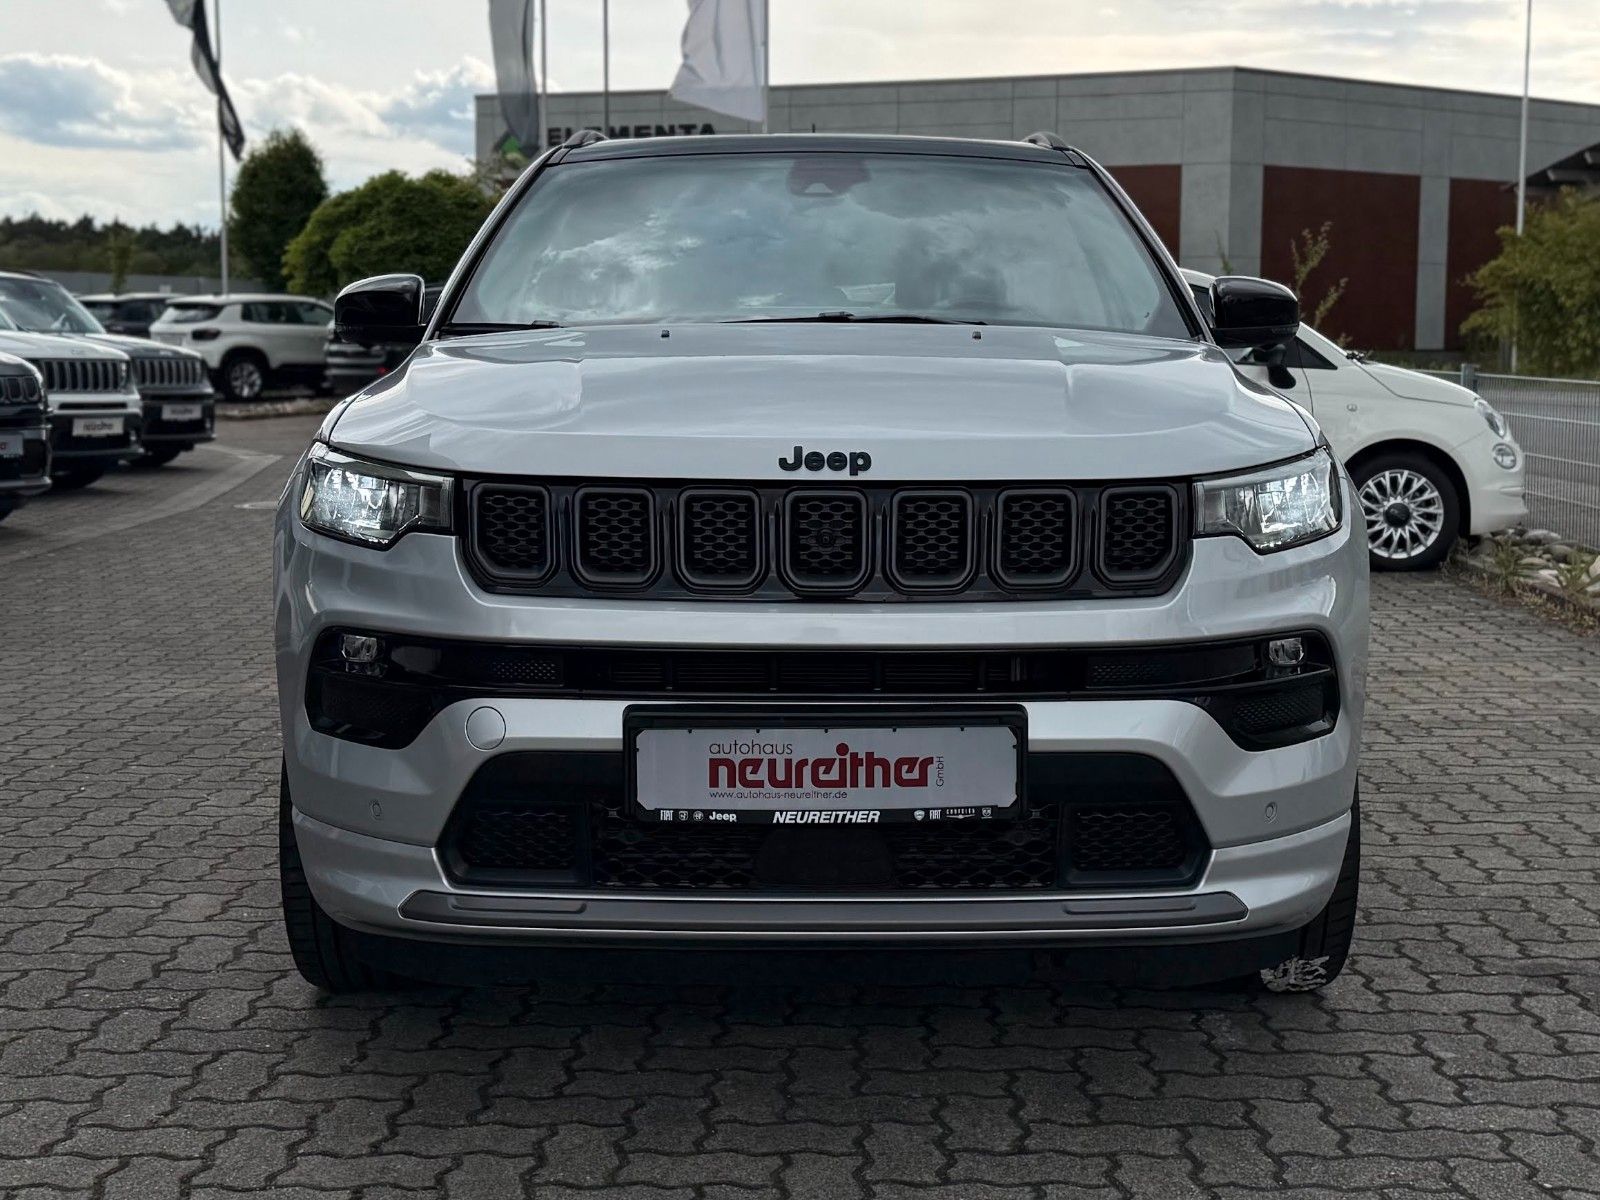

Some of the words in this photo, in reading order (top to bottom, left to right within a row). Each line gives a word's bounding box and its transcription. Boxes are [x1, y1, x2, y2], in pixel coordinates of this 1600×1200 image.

[547, 123, 716, 146] EMENTA
[778, 445, 872, 476] Jeep
[709, 740, 793, 755] autohaus
[708, 742, 934, 788] neureither
[936, 755, 945, 787] GmbH
[709, 791, 848, 799] www.autohaus-neureither.de
[708, 811, 737, 822] Jeep
[772, 810, 881, 824] NEUREITHER
[929, 809, 942, 820] FIAT
